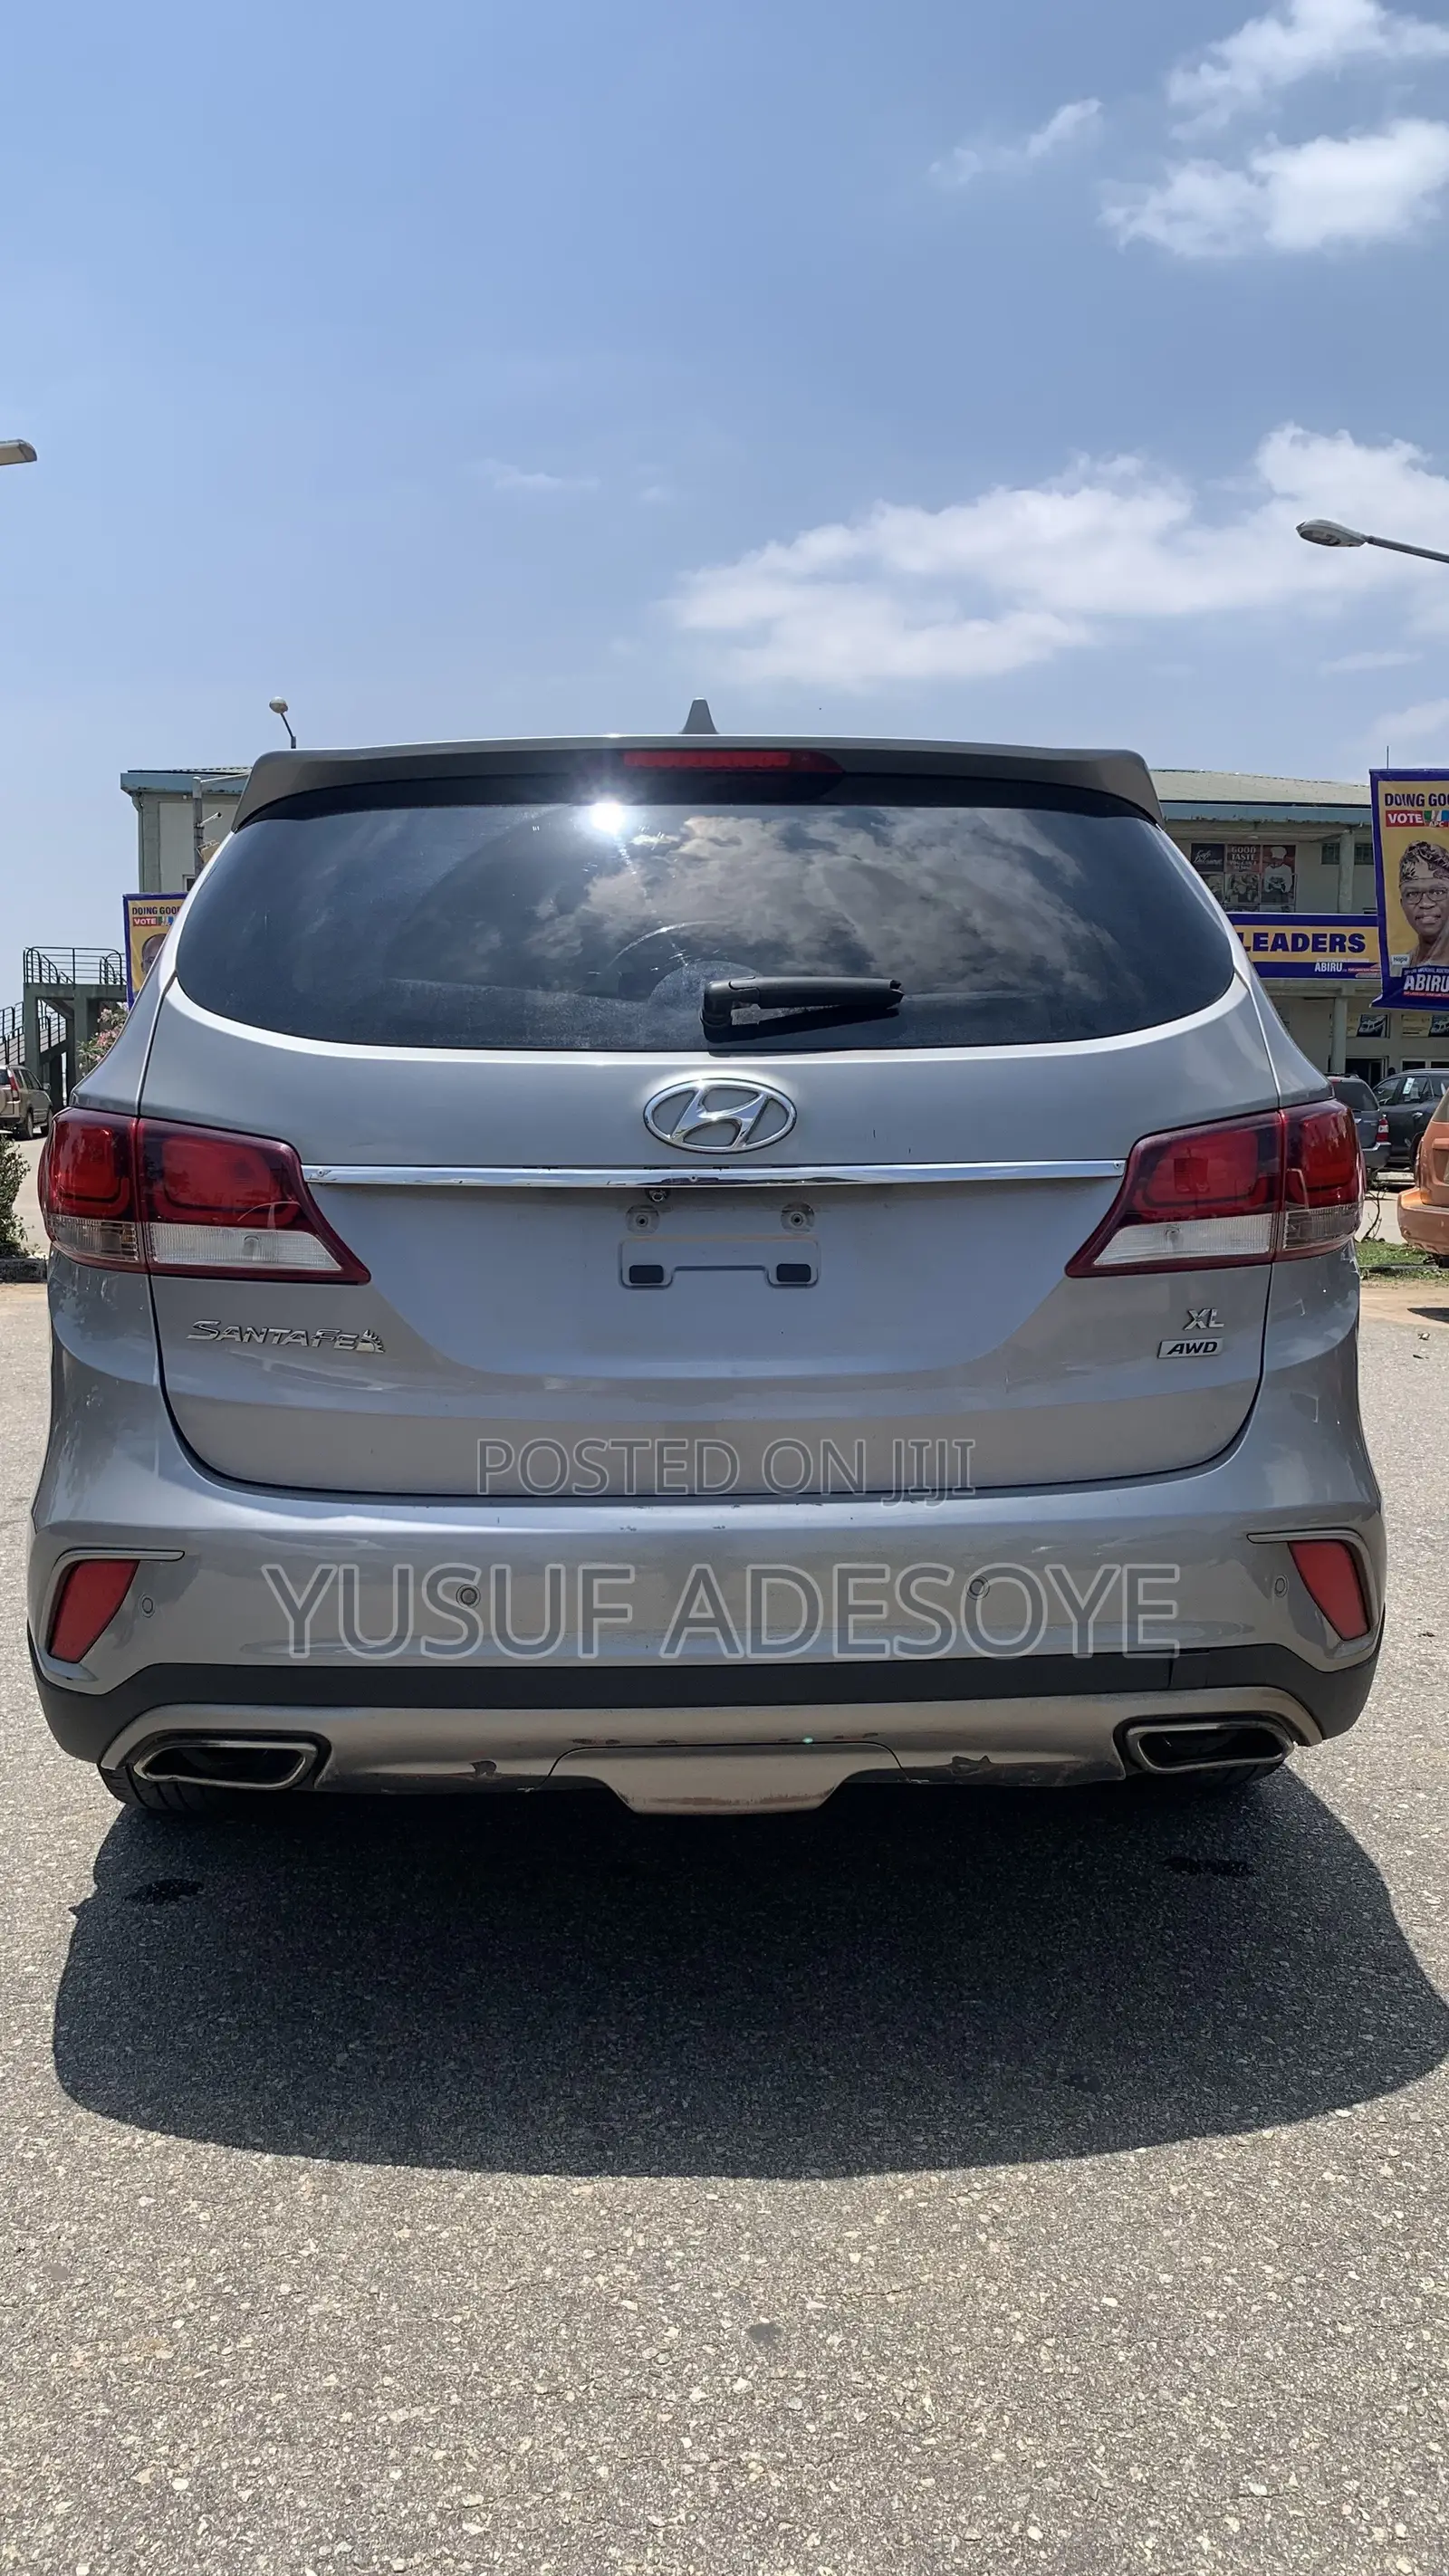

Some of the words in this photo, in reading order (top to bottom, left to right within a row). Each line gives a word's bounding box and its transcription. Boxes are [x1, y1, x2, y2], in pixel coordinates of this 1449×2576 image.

[1385, 793, 1425, 807] DOING
[1428, 793, 1449, 807] GO
[1387, 813, 1423, 824] VOTE
[1232, 846, 1256, 854] GOOD
[1232, 853, 1257, 861] TASTE
[1314, 962, 1343, 972] ABIRU
[1404, 974, 1449, 992] ABIRU
[1183, 1307, 1224, 1330] XL
[1166, 1341, 1218, 1355] AWD
